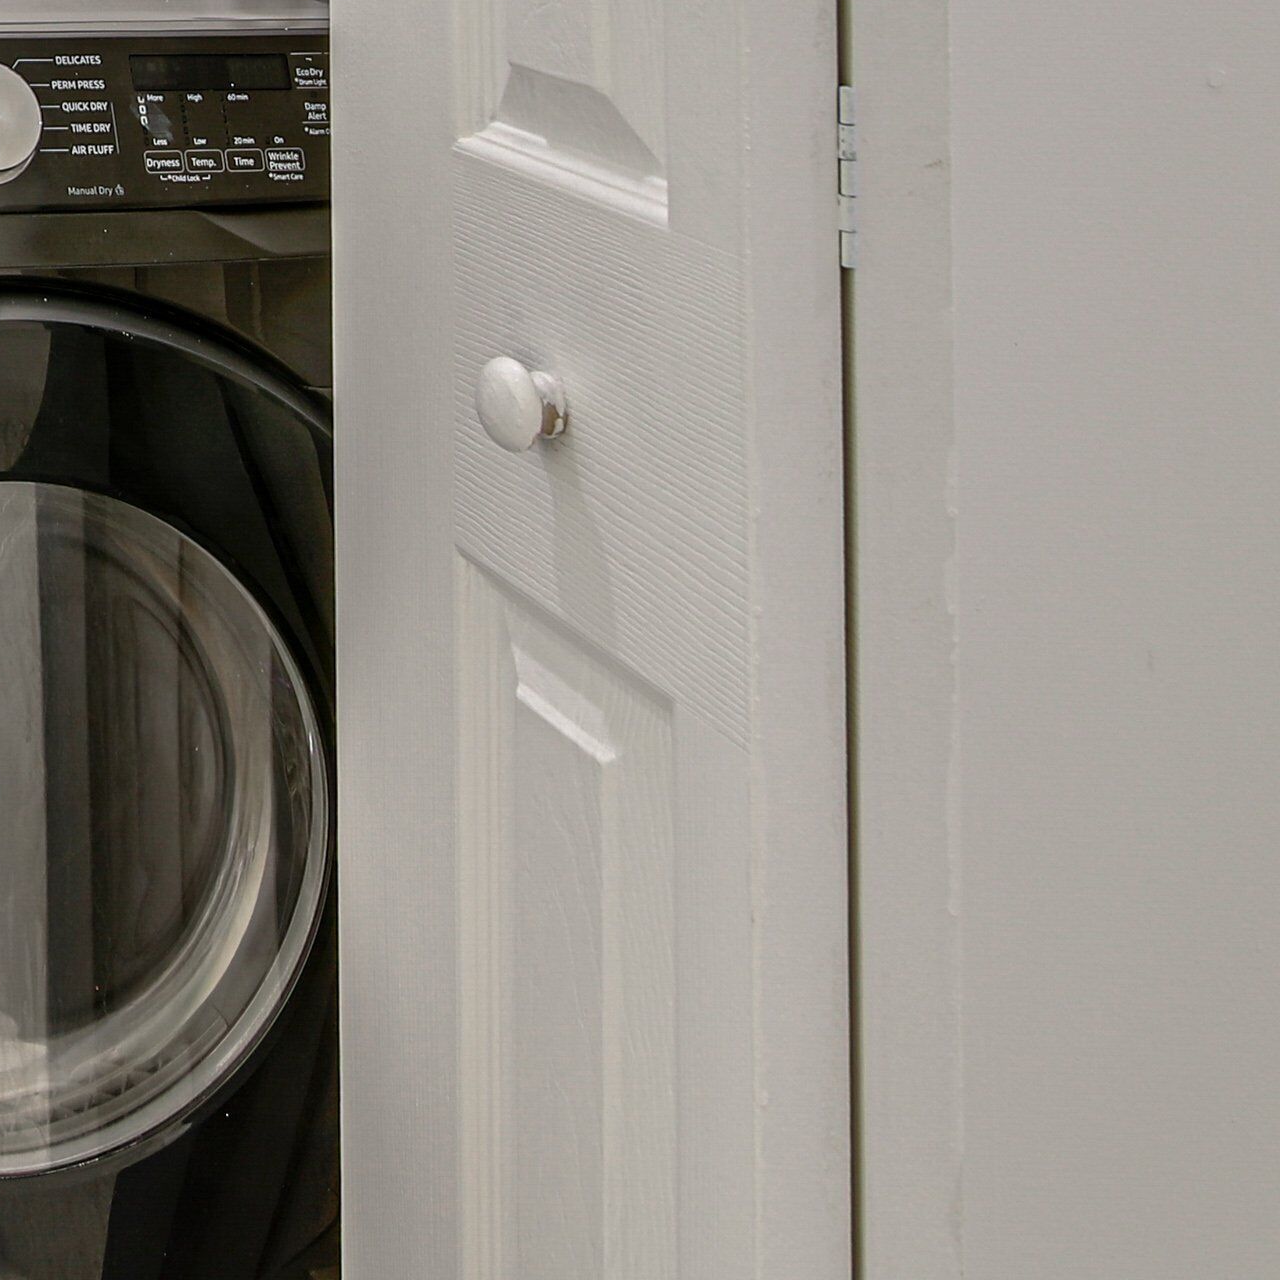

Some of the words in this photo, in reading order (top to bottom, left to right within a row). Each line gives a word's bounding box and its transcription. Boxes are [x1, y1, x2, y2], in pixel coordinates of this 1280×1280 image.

[55, 55, 101, 65] DELICATES
[296, 68, 310, 76] Eco
[309, 68, 323, 77] Dry
[51, 80, 76, 90] PERM
[77, 80, 105, 89] PRESS
[187, 94, 203, 102] High
[62, 102, 90, 112] QUICK
[89, 102, 108, 111] DRY
[304, 102, 327, 111] Damp
[308, 112, 327, 120] Alert
[70, 123, 92, 132] TIME
[93, 123, 111, 132] DRY
[72, 145, 89, 154] AIR
[89, 145, 114, 154] FLUFF
[267, 152, 299, 161] Wrinkle
[146, 157, 180, 169] Dryness
[191, 158, 217, 168] Temp.
[233, 157, 254, 166] Time
[269, 161, 302, 171] Prevent
[68, 186, 98, 195] Manual
[98, 186, 113, 196] Dry
